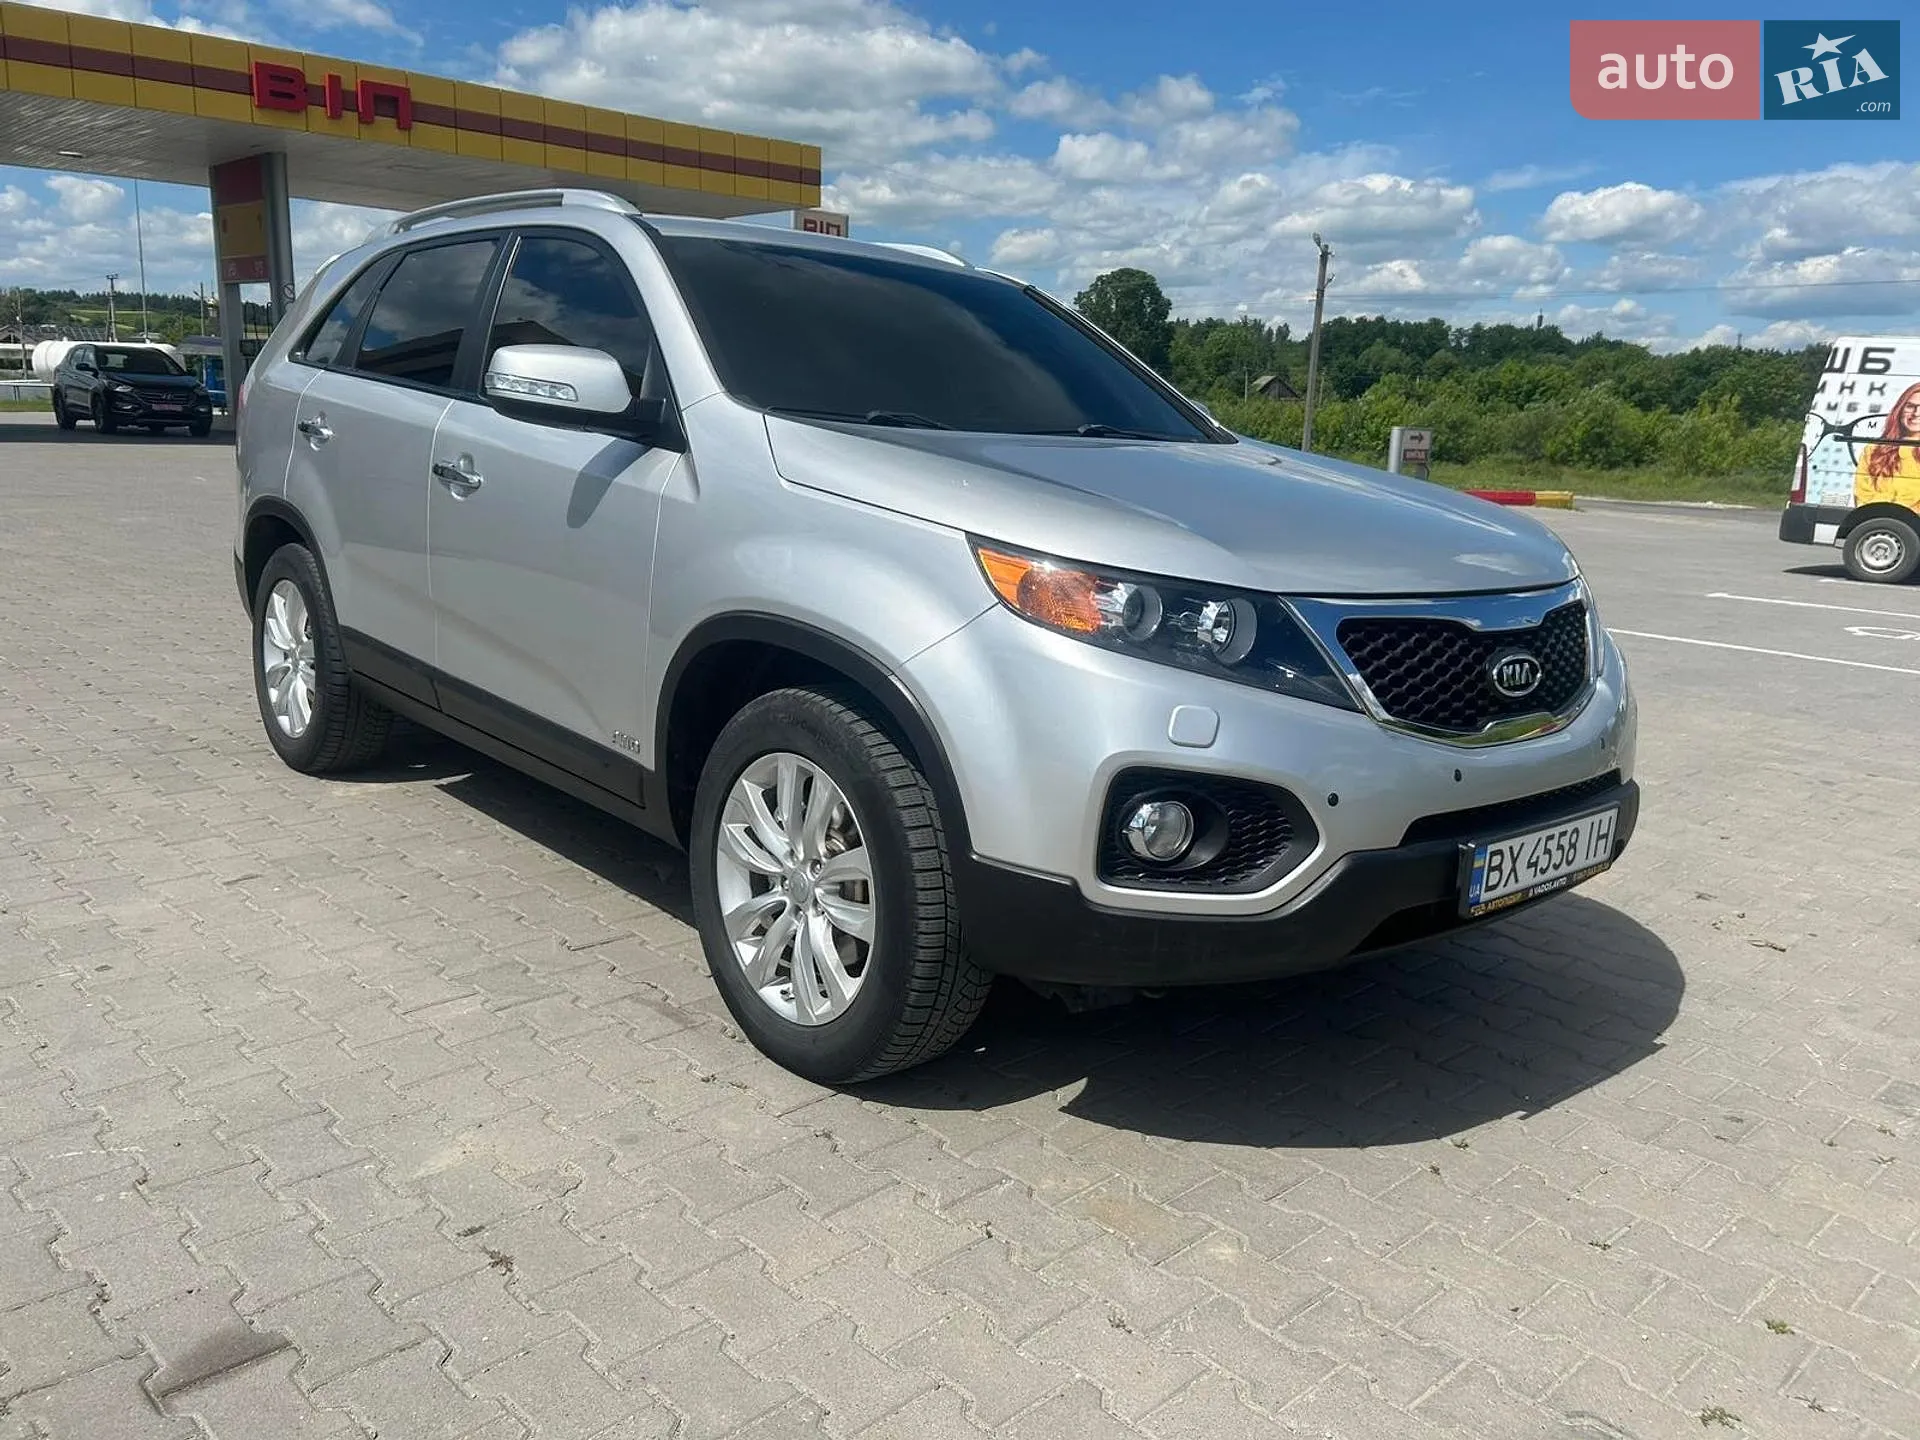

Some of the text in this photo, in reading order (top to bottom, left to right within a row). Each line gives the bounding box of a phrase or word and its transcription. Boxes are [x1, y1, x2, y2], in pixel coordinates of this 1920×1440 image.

[1502, 662, 1532, 687] KIA
[1484, 842, 1525, 893] BX
[1526, 827, 1580, 878] 4558
[1585, 815, 1613, 860] IH
[1469, 883, 1480, 898] UA
